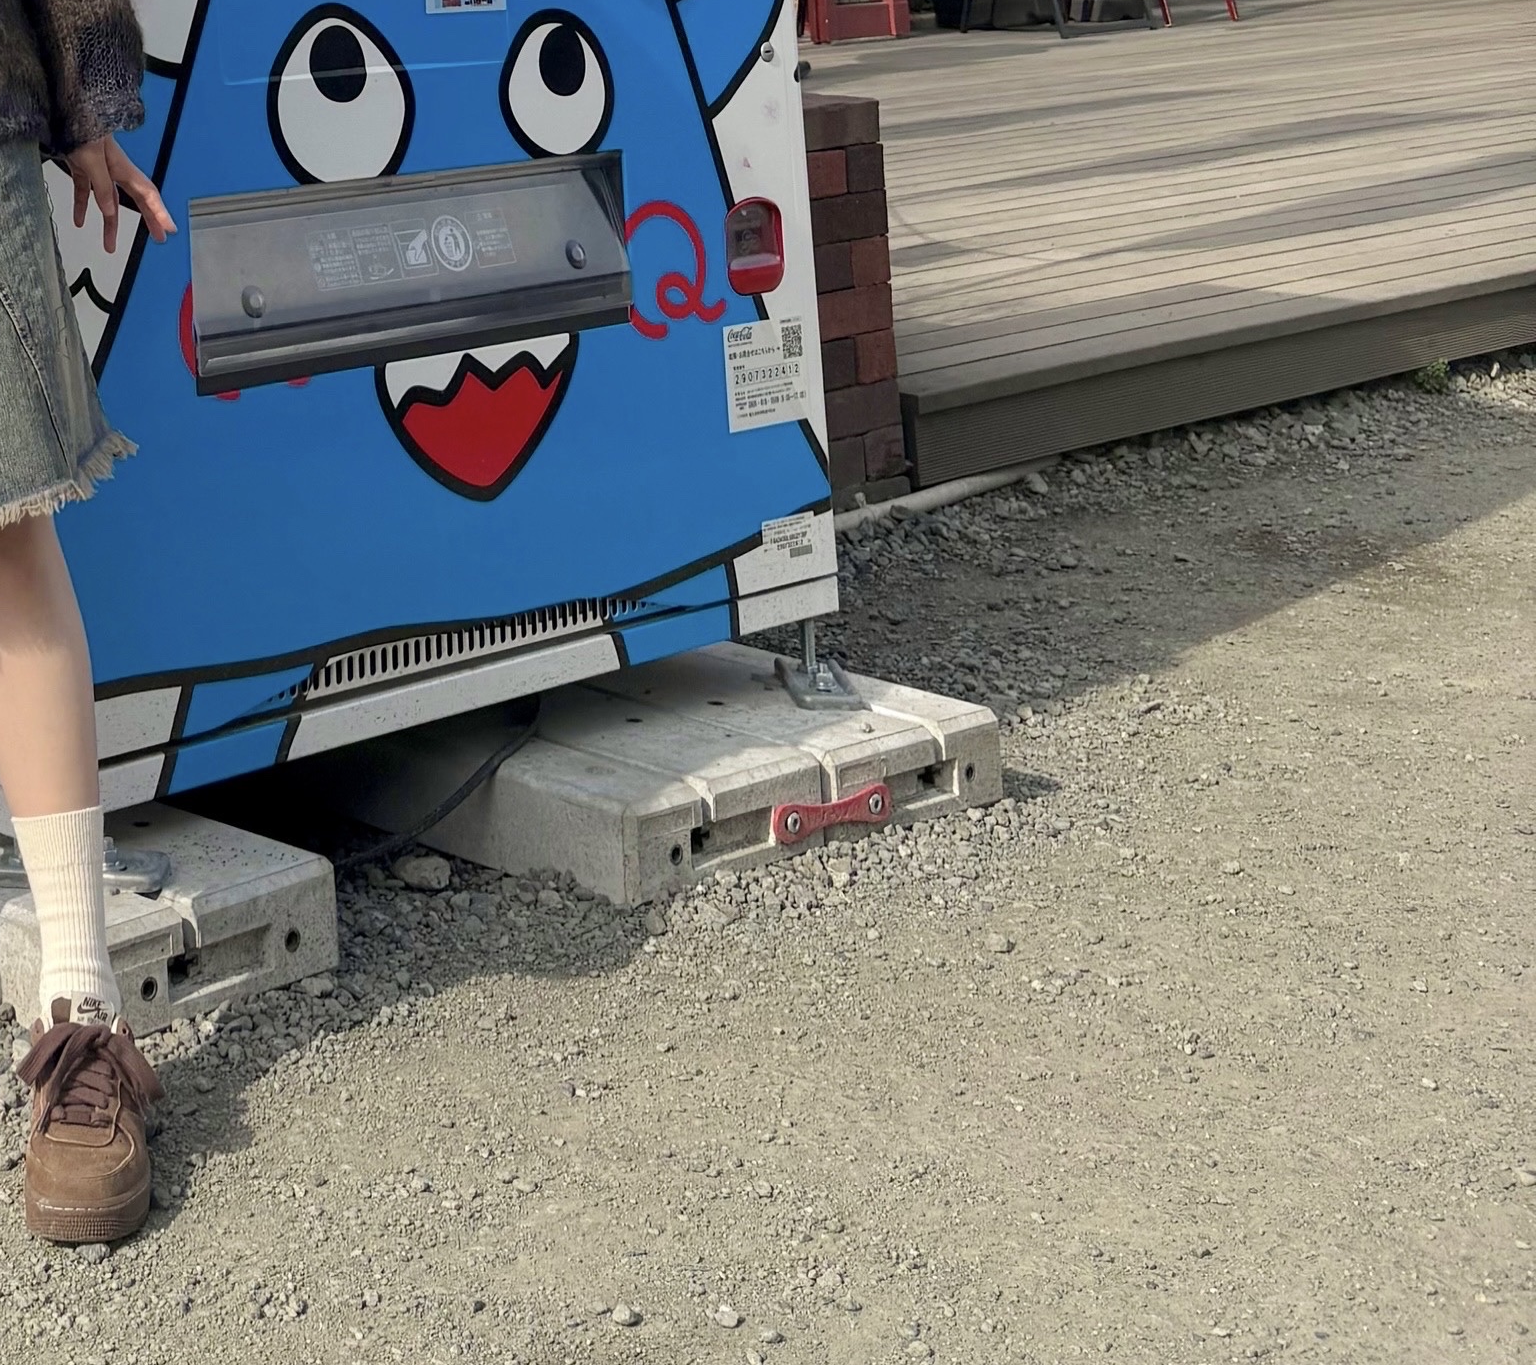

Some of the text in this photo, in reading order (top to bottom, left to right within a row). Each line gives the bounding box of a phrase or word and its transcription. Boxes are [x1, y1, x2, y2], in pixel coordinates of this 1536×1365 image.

[727, 326, 753, 343] Coca-Cola
[82, 996, 105, 1008] NIKE
[94, 1010, 108, 1023] AIR
